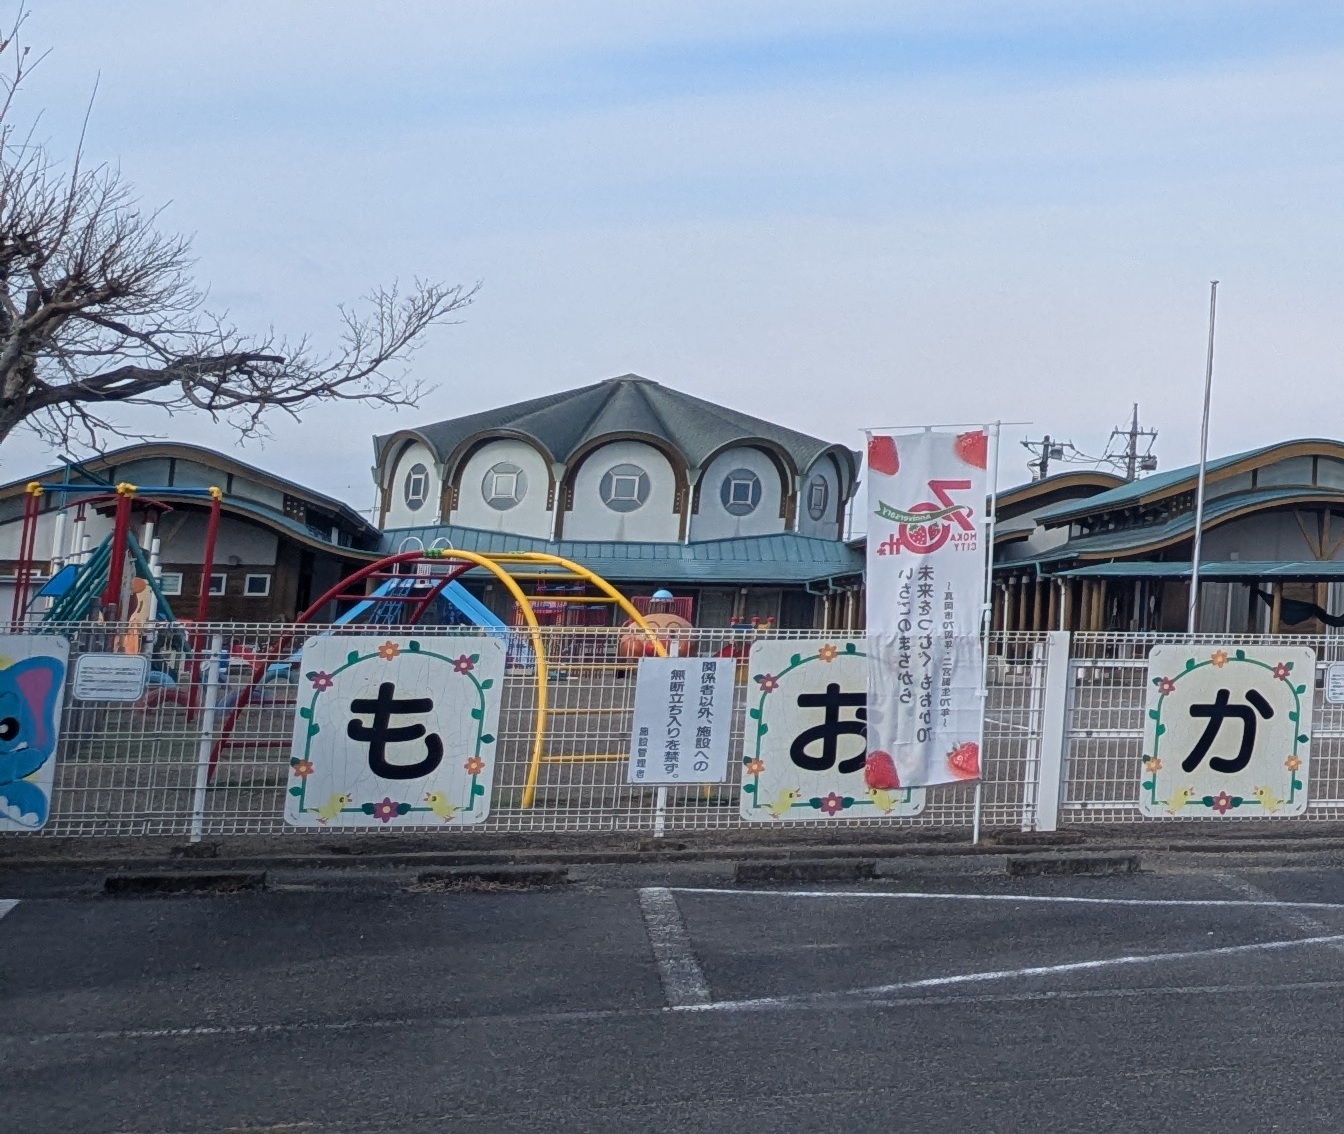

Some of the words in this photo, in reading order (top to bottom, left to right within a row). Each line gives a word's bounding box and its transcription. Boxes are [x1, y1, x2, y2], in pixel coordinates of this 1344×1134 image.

[347, 681, 444, 780] も
[790, 683, 868, 774] お
[1181, 687, 1274, 774] か
[636, 727, 649, 779] 施設管理者
[663, 669, 686, 779] 無断立ち入りを禁ず。
[693, 662, 717, 772] 関係者以外、施設への
